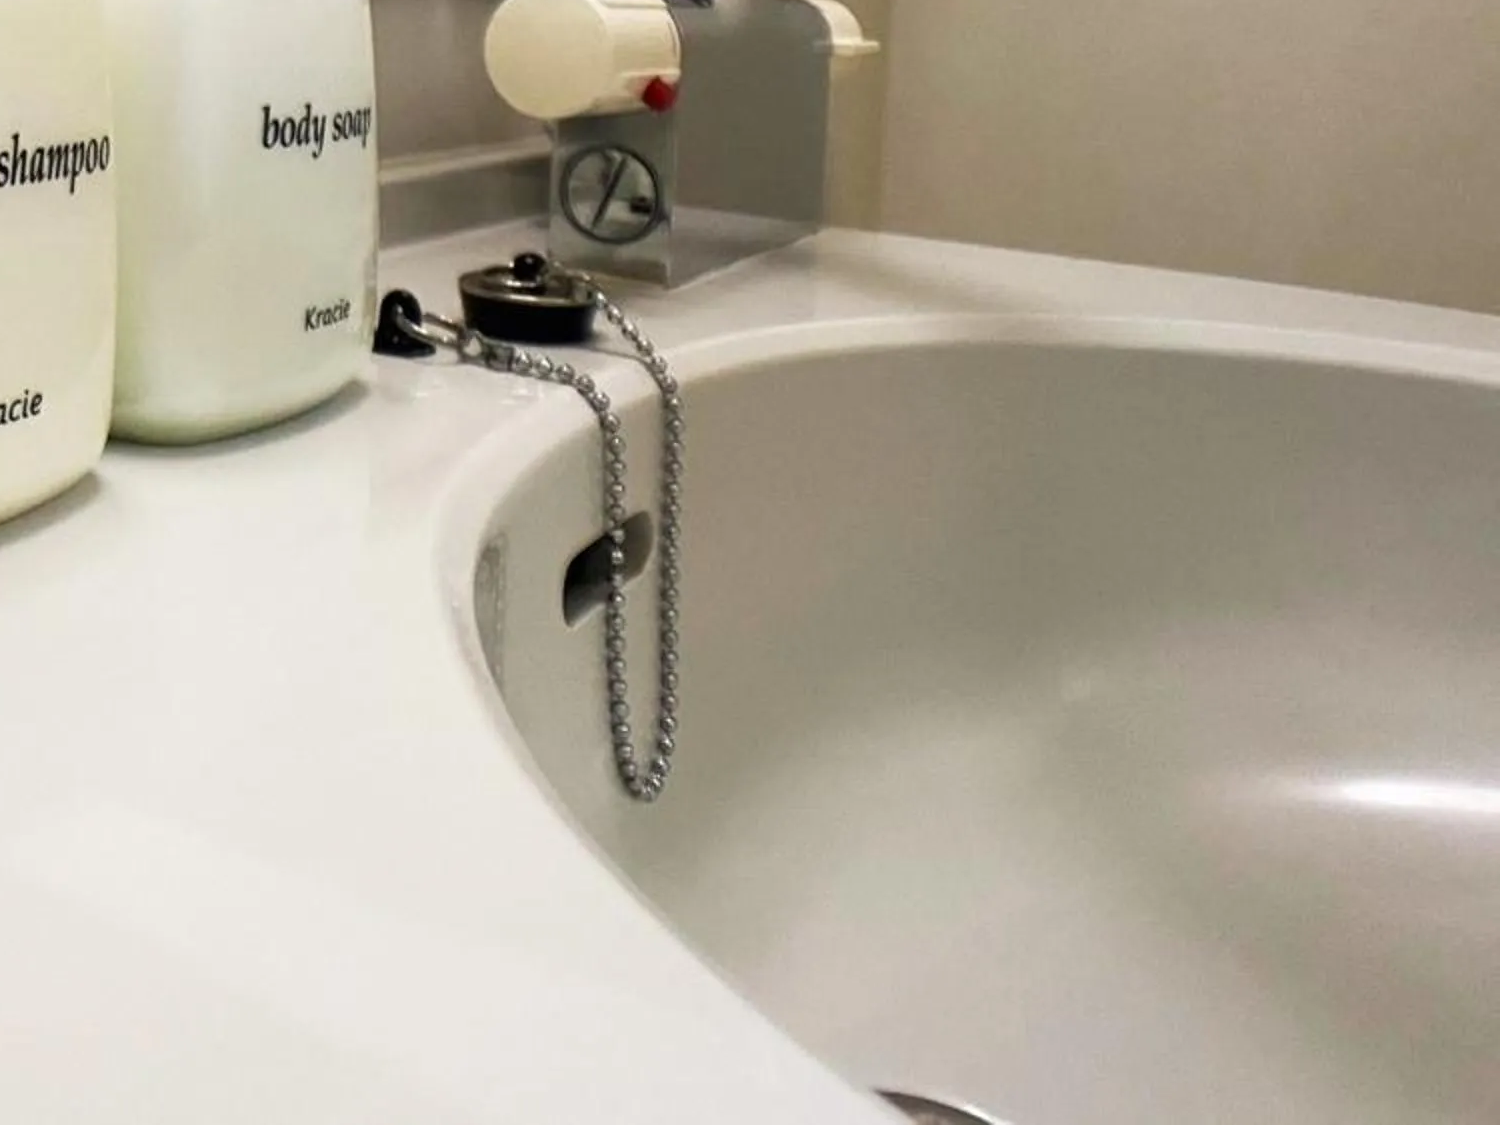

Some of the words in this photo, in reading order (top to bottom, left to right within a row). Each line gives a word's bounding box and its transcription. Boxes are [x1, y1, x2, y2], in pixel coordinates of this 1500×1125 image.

[261, 102, 327, 160] body
[331, 107, 371, 149] soap
[303, 297, 351, 332] Kracie
